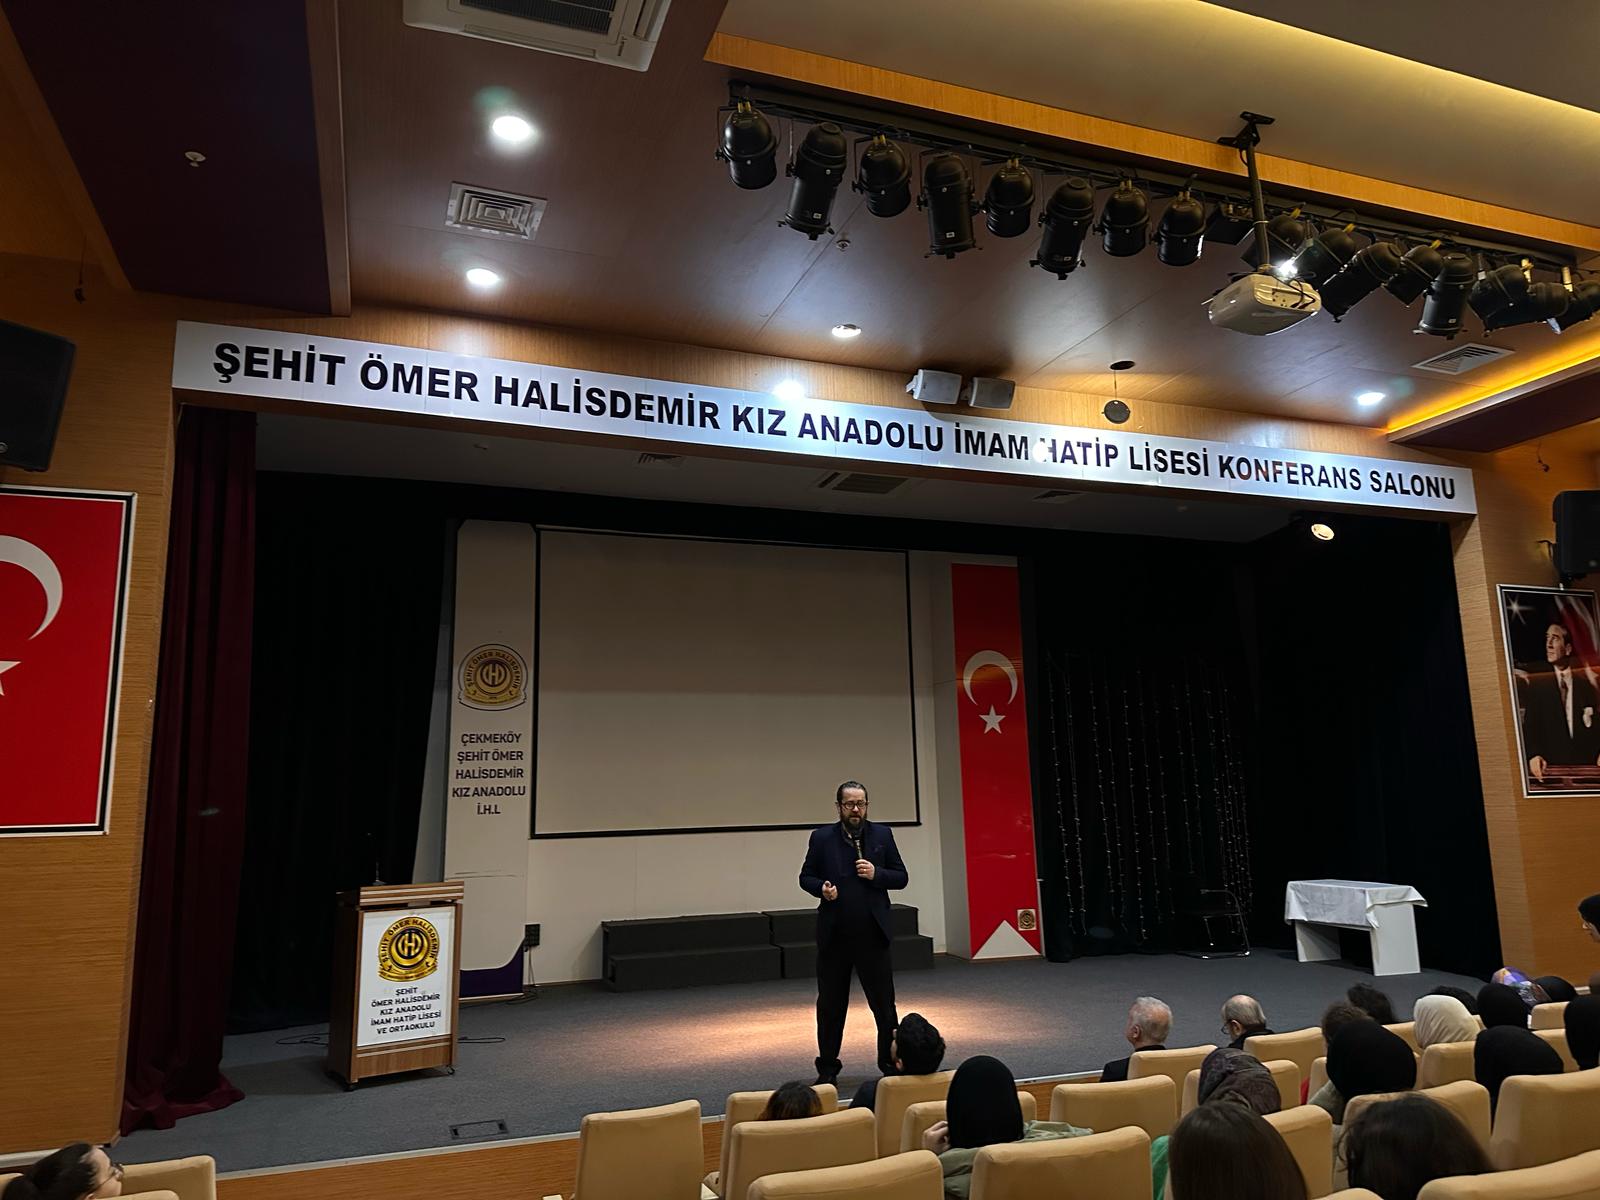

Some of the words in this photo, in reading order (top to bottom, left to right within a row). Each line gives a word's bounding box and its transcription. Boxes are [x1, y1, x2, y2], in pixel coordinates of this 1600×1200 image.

[213, 342, 345, 384] ŞEHİT
[360, 353, 480, 402] ÖMER
[494, 376, 720, 431] HALİSDEMİR
[732, 405, 787, 437] KIZ
[798, 412, 944, 453] ANADOLU
[954, 421, 1029, 461] İMAM
[1129, 441, 1210, 477] LİSESİ
[1218, 455, 1362, 491] KONFERANS
[1369, 470, 1456, 500] SALONU
[461, 731, 522, 746] ÇEKMEKÖY
[457, 749, 490, 764] ŞEHİT
[492, 748, 523, 761] ÖMER
[455, 766, 524, 779] HALİSDEMİR
[452, 787, 470, 798] KIZ
[472, 786, 526, 797] ANADOLU
[395, 986, 418, 996] ŞEHİT
[371, 999, 393, 1007] ÖMER
[395, 993, 441, 1004] HALİSDEMİR
[395, 1004, 432, 1013] ANADOLU
[370, 1017, 392, 1026] İMAM
[393, 1013, 417, 1023] HATİP
[418, 1010, 442, 1020] LİSESİ
[376, 1027, 388, 1035] VE
[389, 1021, 436, 1033] ORTAOKULU
